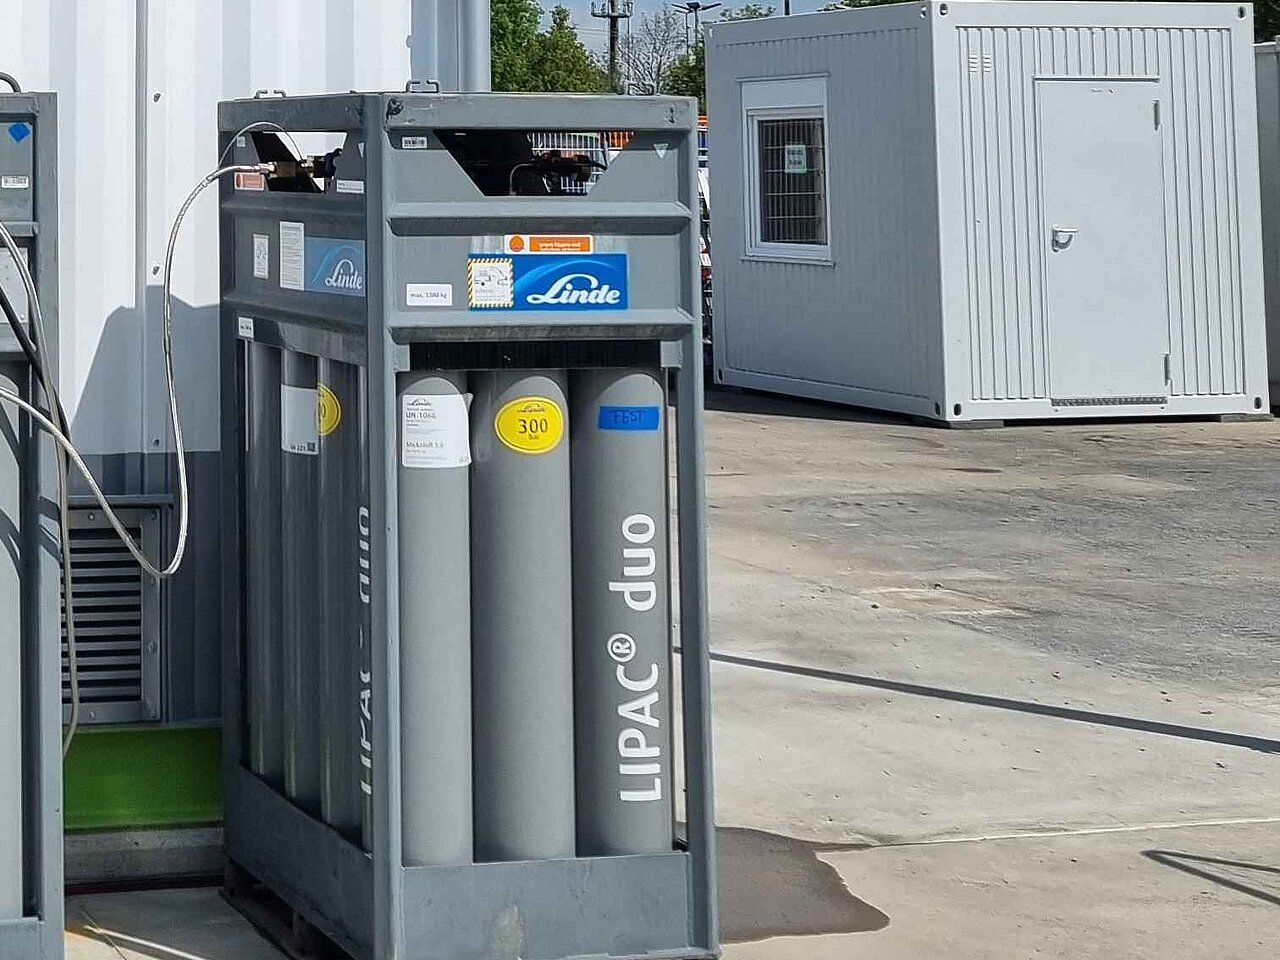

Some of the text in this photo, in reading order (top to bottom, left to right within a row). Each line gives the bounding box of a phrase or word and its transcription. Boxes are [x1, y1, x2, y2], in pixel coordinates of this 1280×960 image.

[324, 258, 364, 289] Linde
[526, 273, 621, 304] Linde
[517, 418, 549, 434] 300
[608, 513, 657, 611] duo
